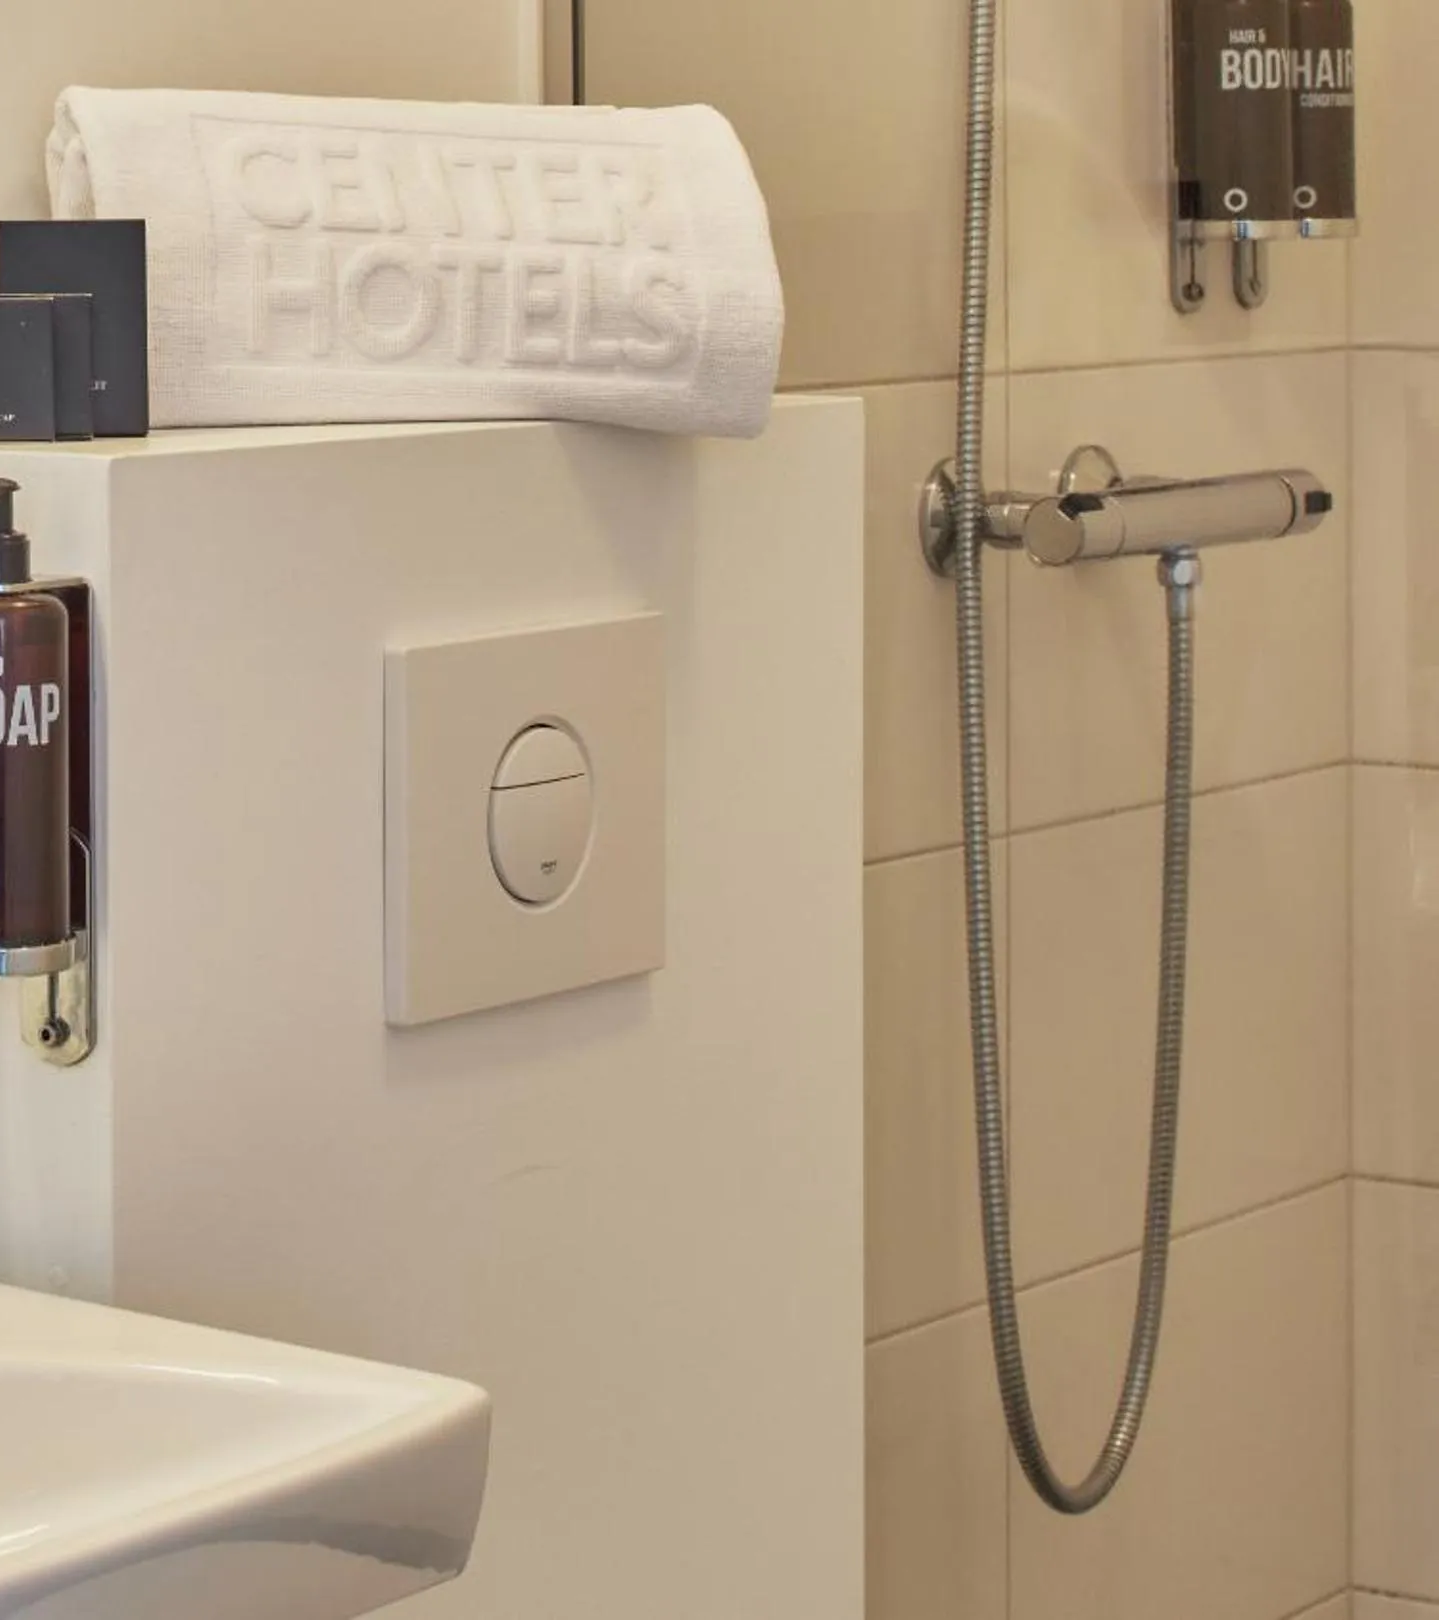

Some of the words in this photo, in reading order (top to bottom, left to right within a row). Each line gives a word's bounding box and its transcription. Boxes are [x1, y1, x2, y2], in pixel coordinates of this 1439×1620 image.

[1221, 48, 1289, 90] BODY
[234, 136, 672, 251] CENTER
[246, 237, 700, 370] HOTELS
